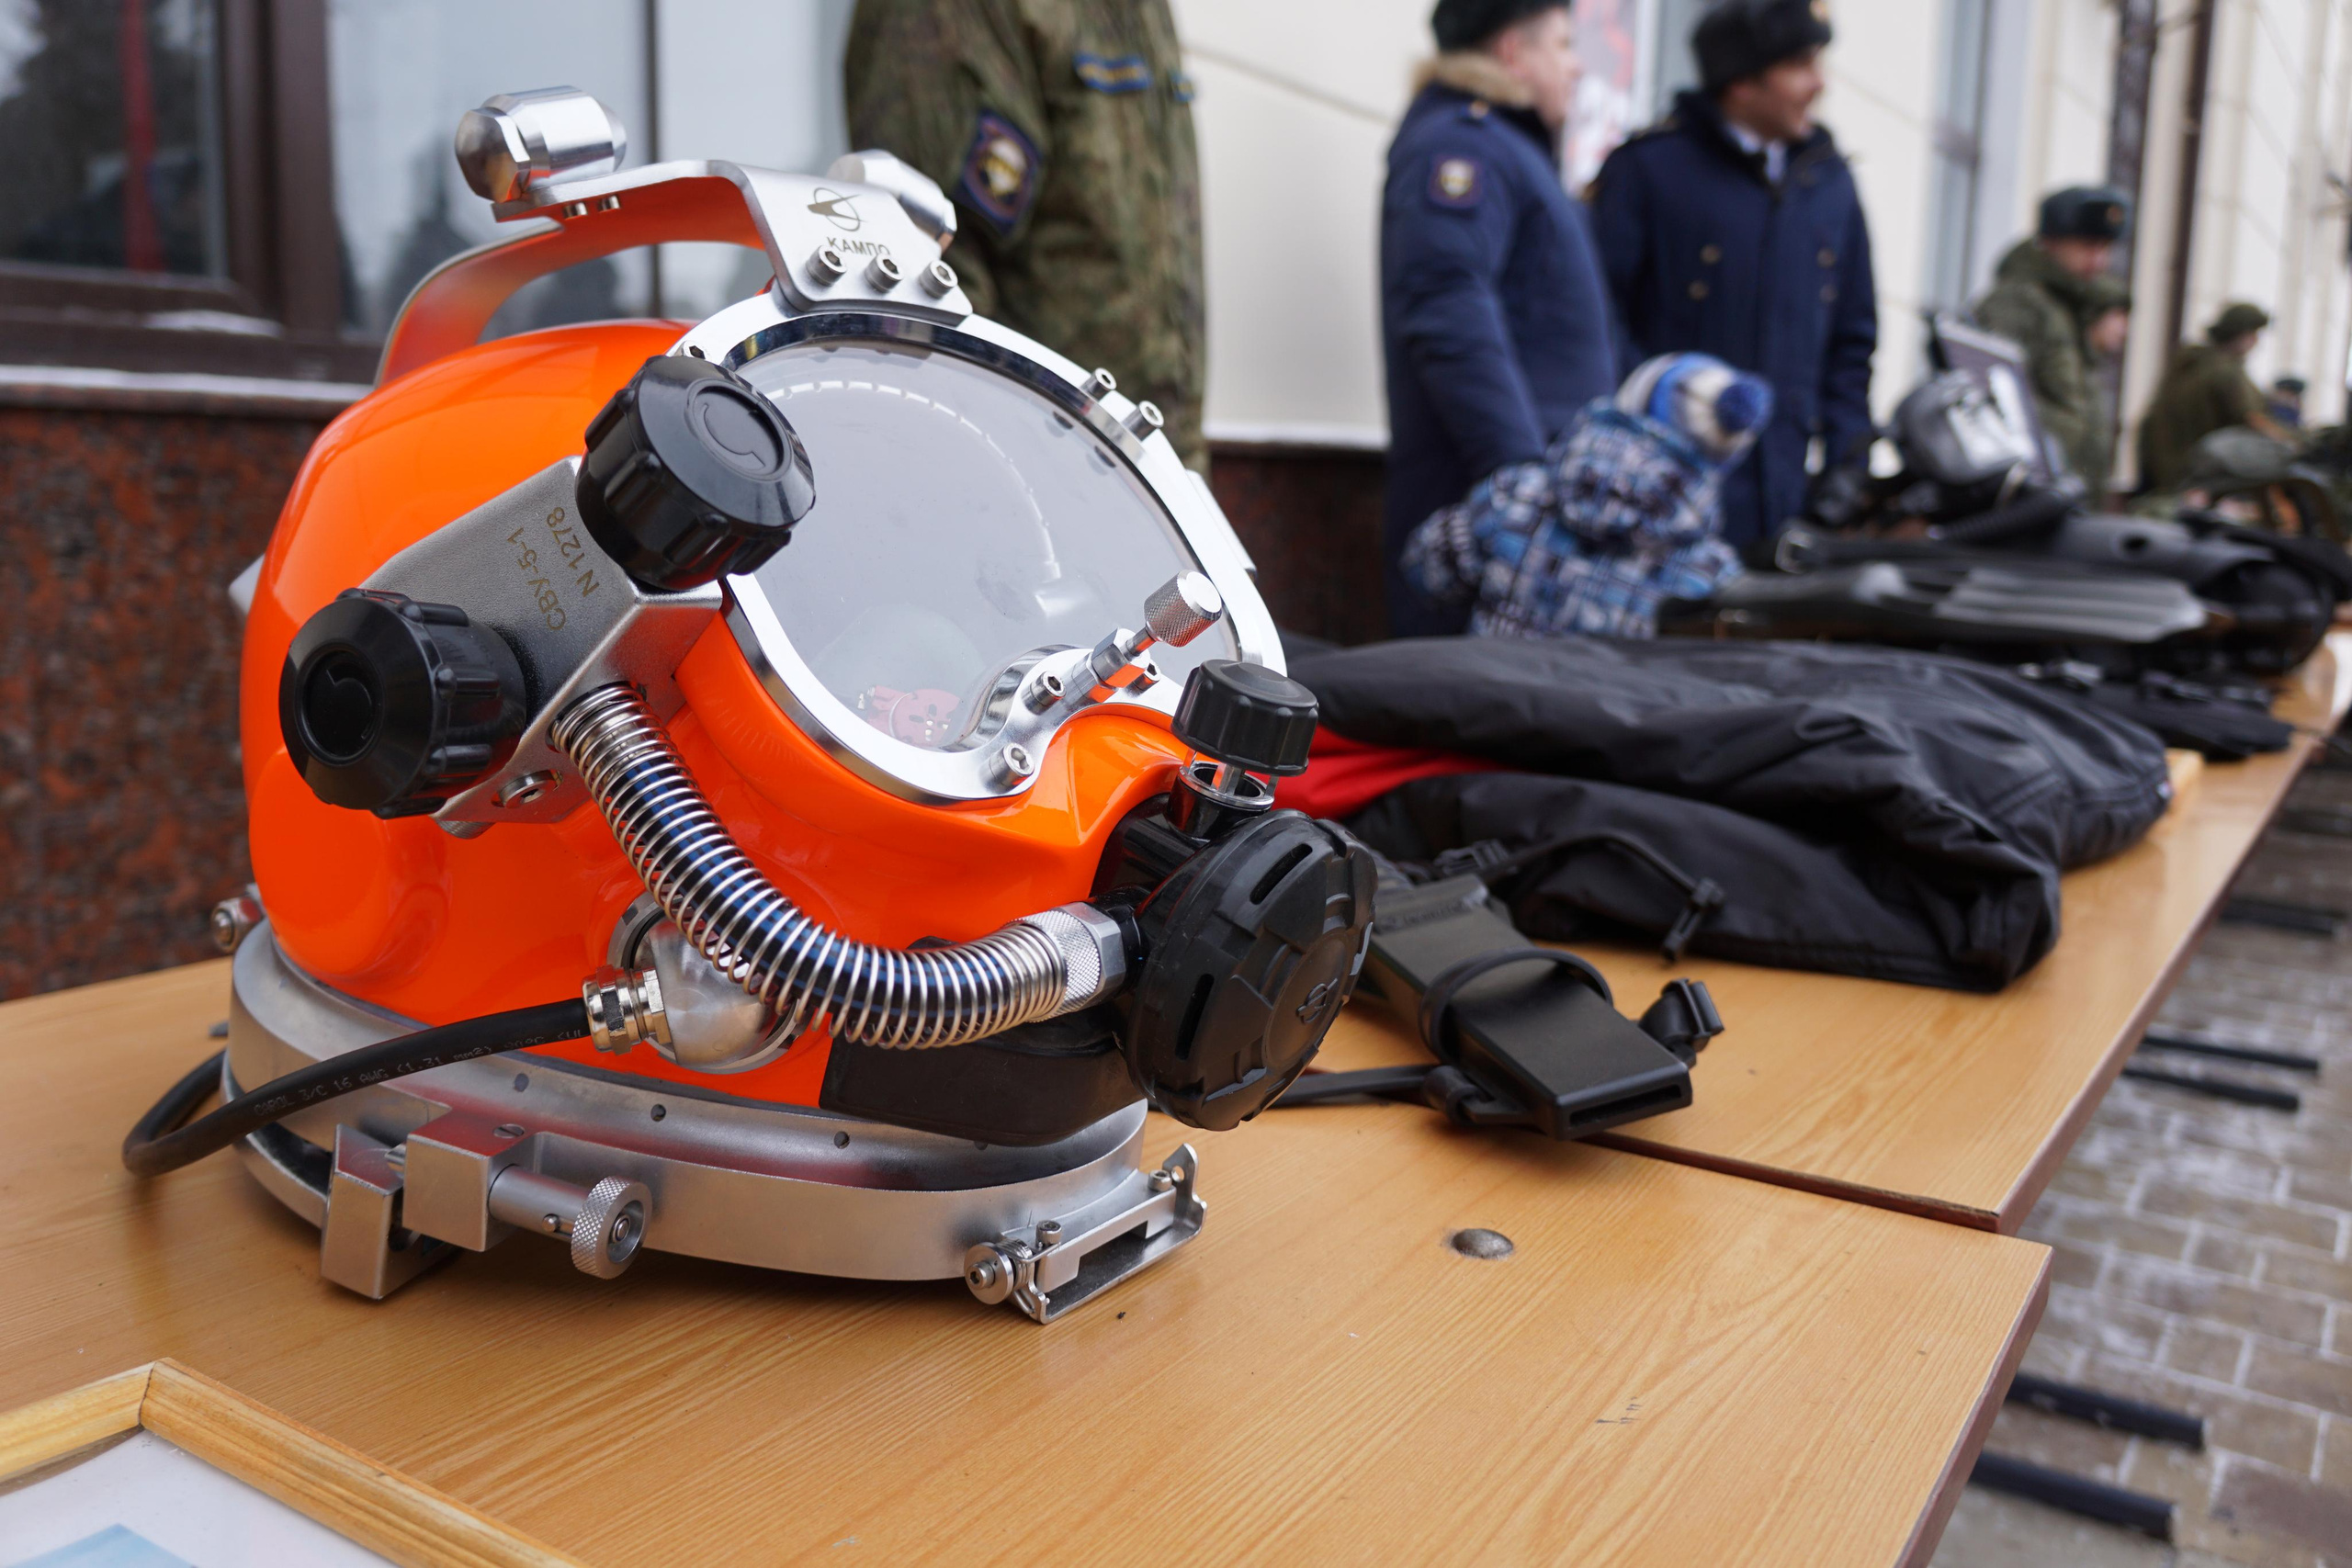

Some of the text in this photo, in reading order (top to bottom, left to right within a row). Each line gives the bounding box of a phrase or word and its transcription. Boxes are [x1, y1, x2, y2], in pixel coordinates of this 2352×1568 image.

[826, 236, 891, 256] КАМПО
[546, 506, 585, 570] 1278
[334, 1075, 353, 1091] 16
[358, 1067, 390, 1084] AWG
